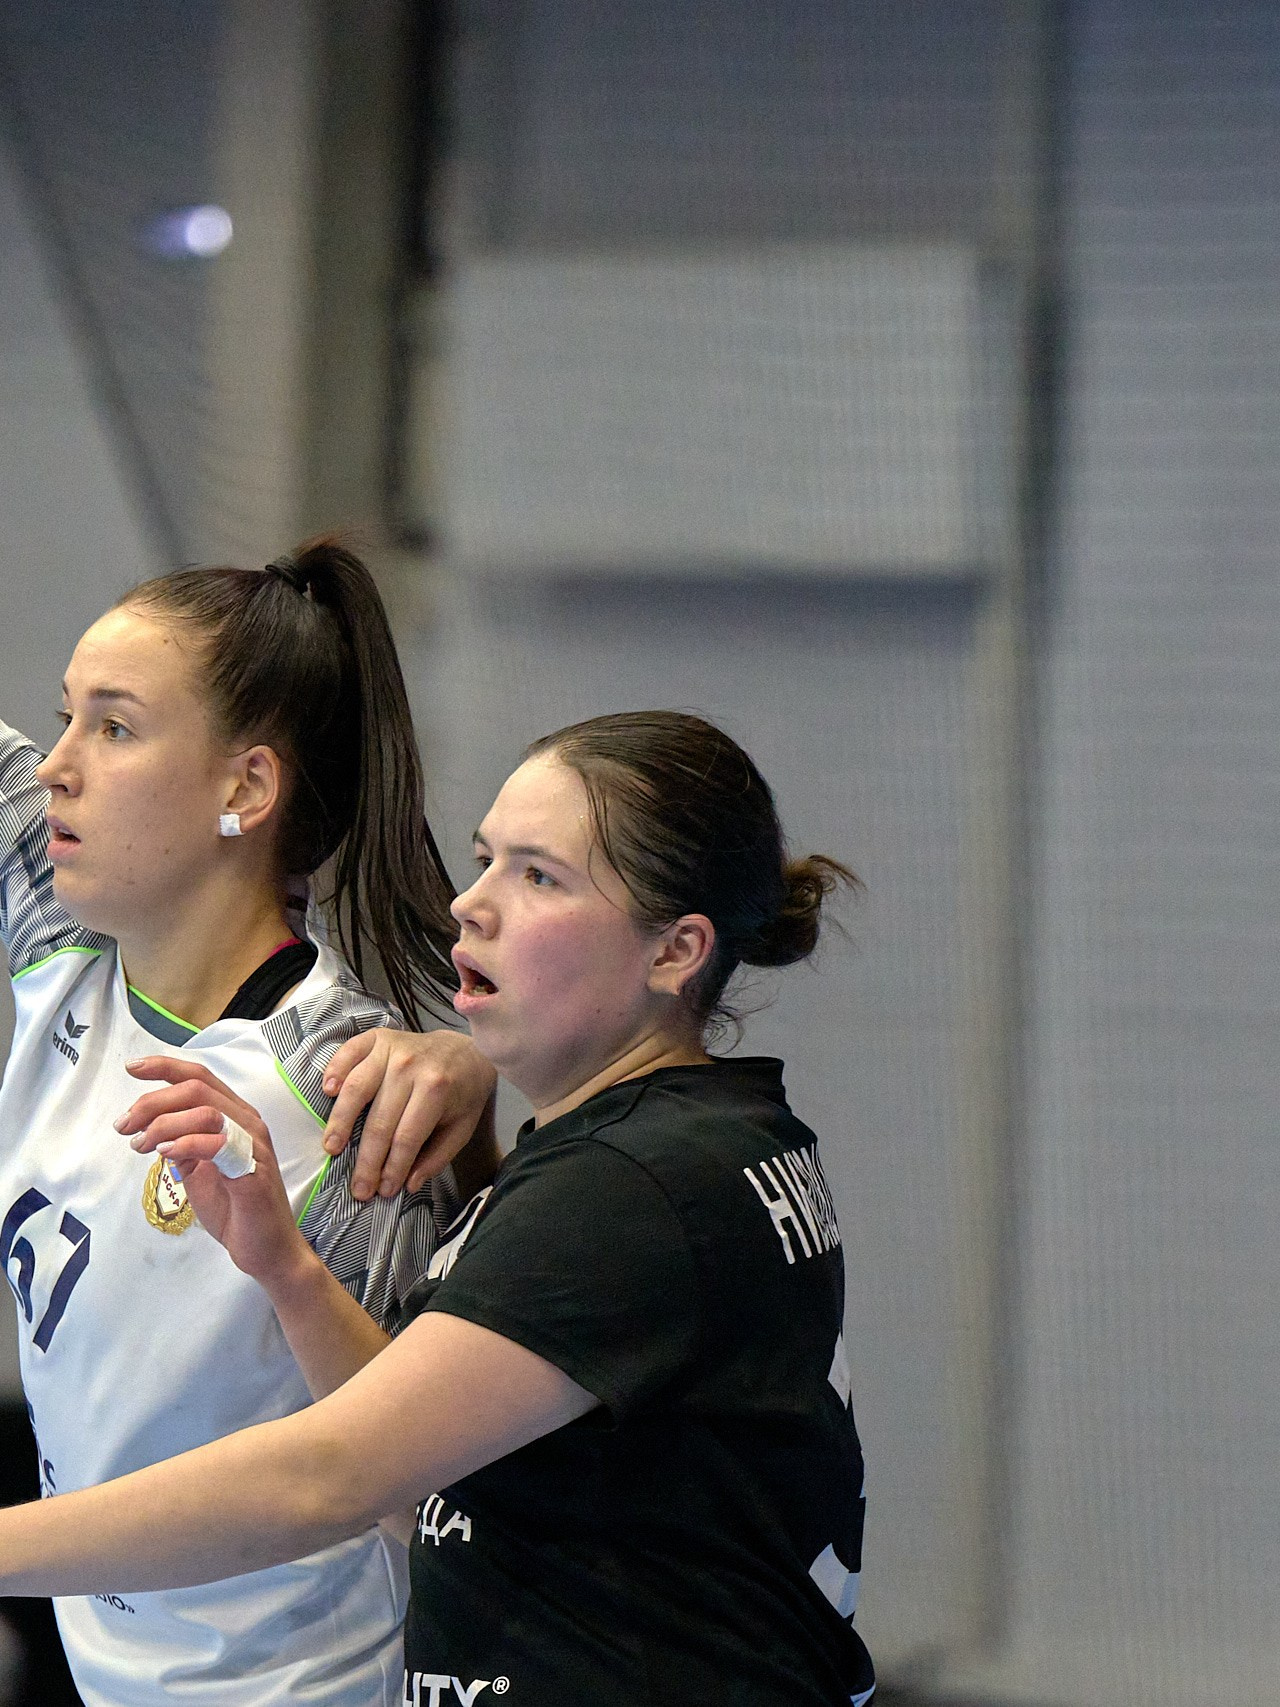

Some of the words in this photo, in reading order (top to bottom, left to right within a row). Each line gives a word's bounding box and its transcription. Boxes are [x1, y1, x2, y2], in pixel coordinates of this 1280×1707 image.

[52, 1031, 80, 1066] erima
[162, 1173, 181, 1207] ЦСКА
[416, 1492, 472, 1546] ДА
